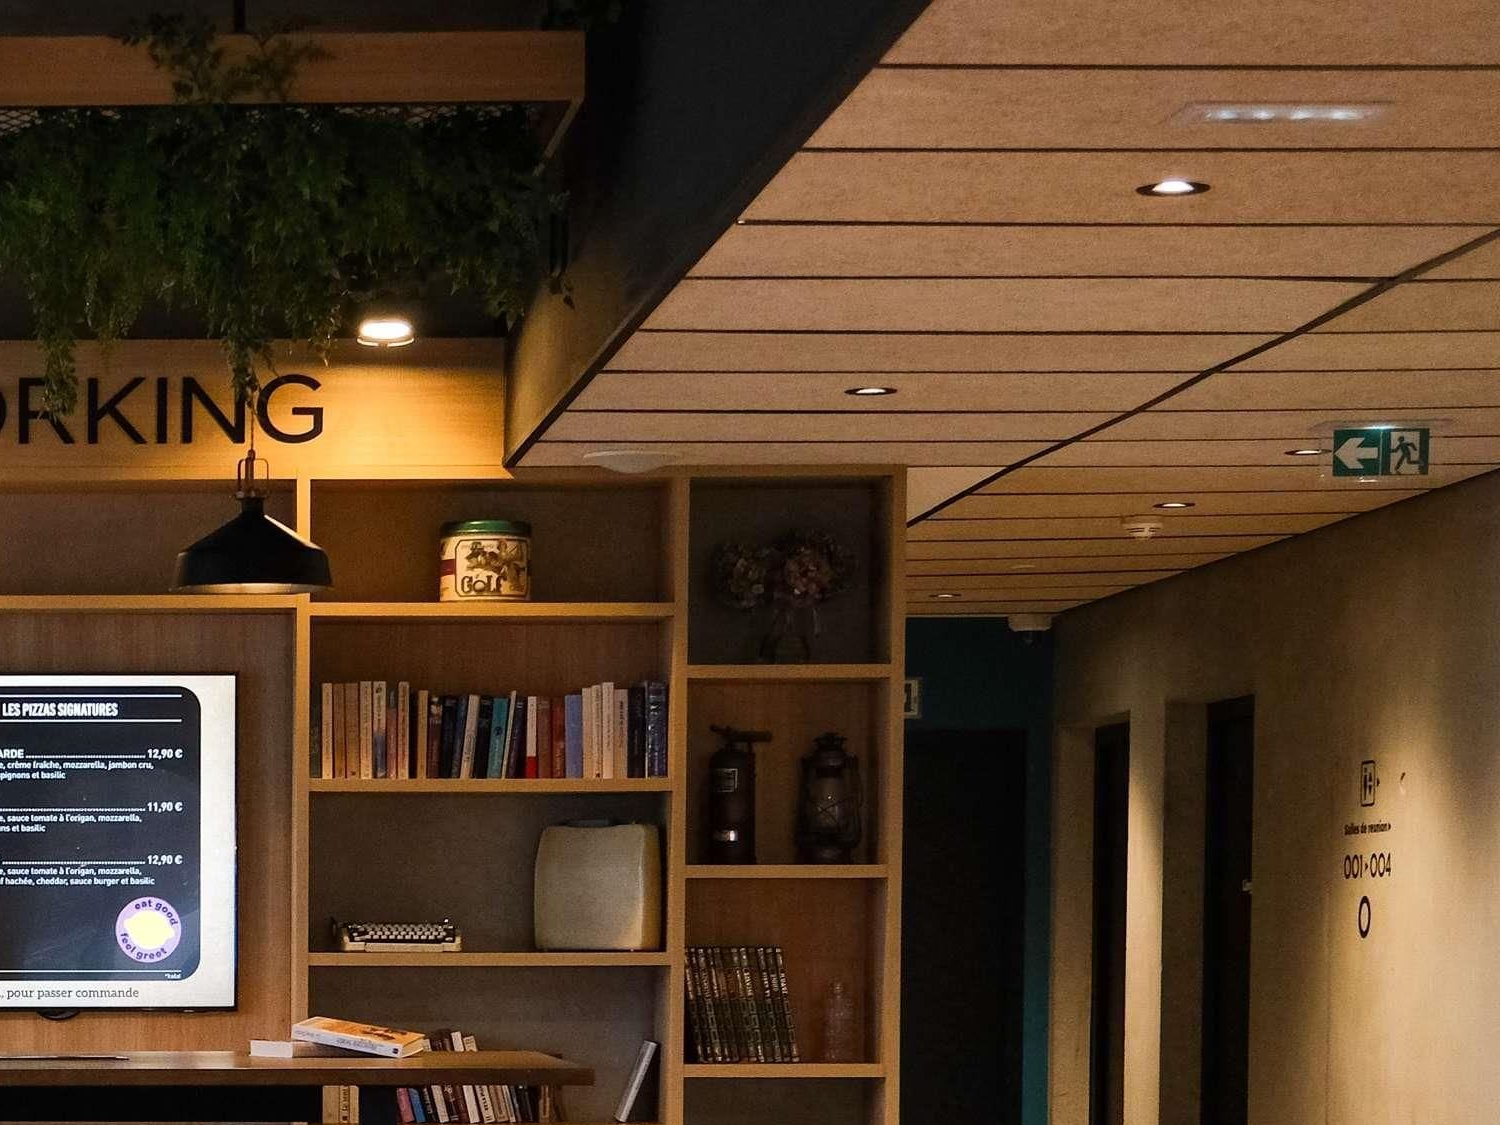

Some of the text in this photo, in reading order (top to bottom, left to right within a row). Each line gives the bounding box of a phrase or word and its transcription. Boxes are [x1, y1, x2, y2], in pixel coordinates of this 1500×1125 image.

[3, 703, 118, 716] LES PIZZAS SIGNATURES
[148, 749, 173, 760] 12,90
[176, 749, 183, 758] €
[41, 771, 66, 779] basilic
[148, 802, 173, 813] 11,90
[176, 802, 183, 812] €
[59, 814, 64, 822] à
[98, 814, 142, 822] mozzarella,
[21, 824, 46, 832] basilic
[148, 855, 173, 866] 12,90
[175, 855, 183, 864] €
[1344, 853, 1391, 879] 001 004
[59, 867, 64, 875] à
[98, 867, 142, 876] mozzarella,
[6, 877, 35, 886] hachée,
[36, 877, 69, 886] cheddar,
[94, 877, 120, 887] burger
[130, 877, 155, 885] basilic
[134, 899, 178, 925] eat good
[120, 932, 167, 960] feel great
[7, 990, 34, 1000] pour
[38, 990, 73, 1000] passer
[76, 988, 139, 998] commande
